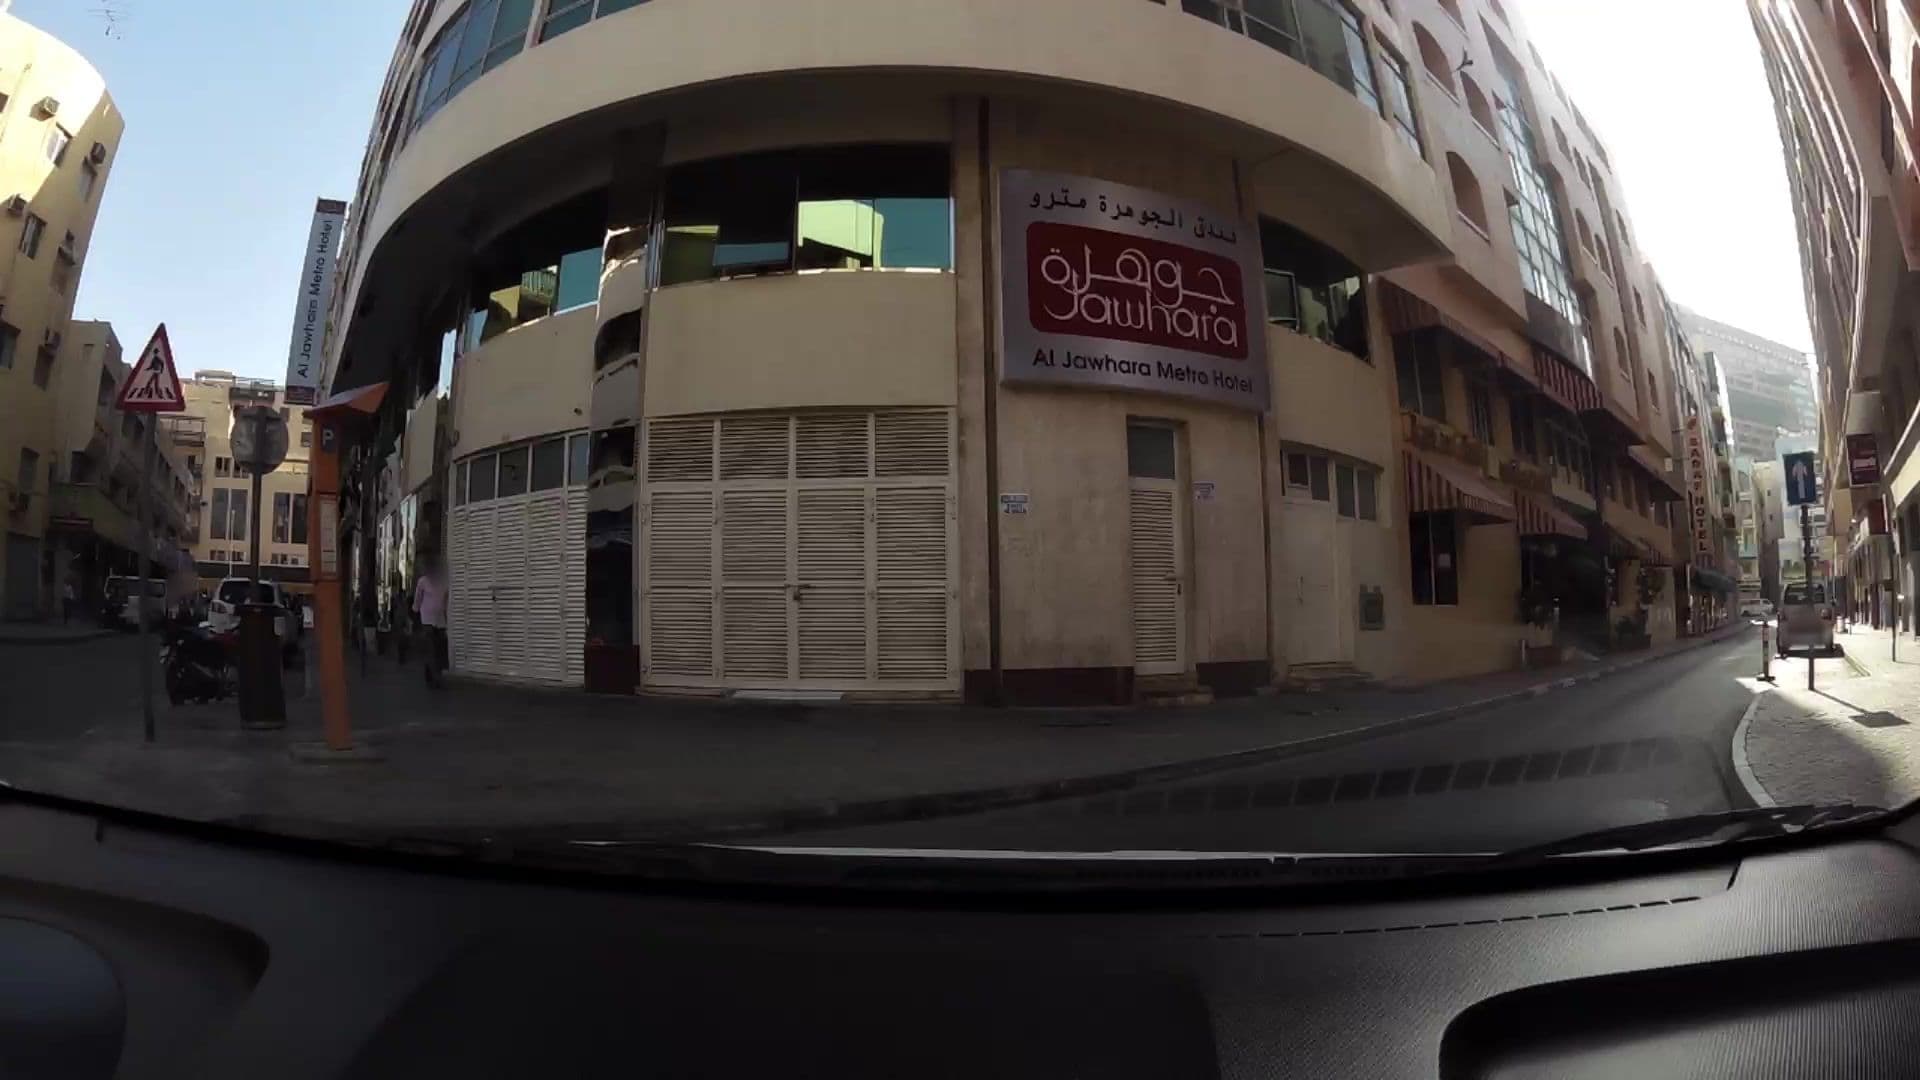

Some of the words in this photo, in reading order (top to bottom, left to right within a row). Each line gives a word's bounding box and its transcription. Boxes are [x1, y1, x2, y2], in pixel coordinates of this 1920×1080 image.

[1029, 187, 1087, 210] مترو
[1099, 194, 1183, 229] الجوهرة
[318, 219, 333, 254] Hotel
[309, 257, 325, 297] Metro
[299, 298, 318, 361] Jawhara
[297, 363, 309, 379] Al
[1032, 348, 1055, 367] Al
[1062, 351, 1152, 377] Jawhara
[1157, 360, 1209, 385] Metro
[1212, 369, 1253, 393] Hotel
[323, 428, 335, 447] P
[1695, 495, 1707, 552] HOTEL
